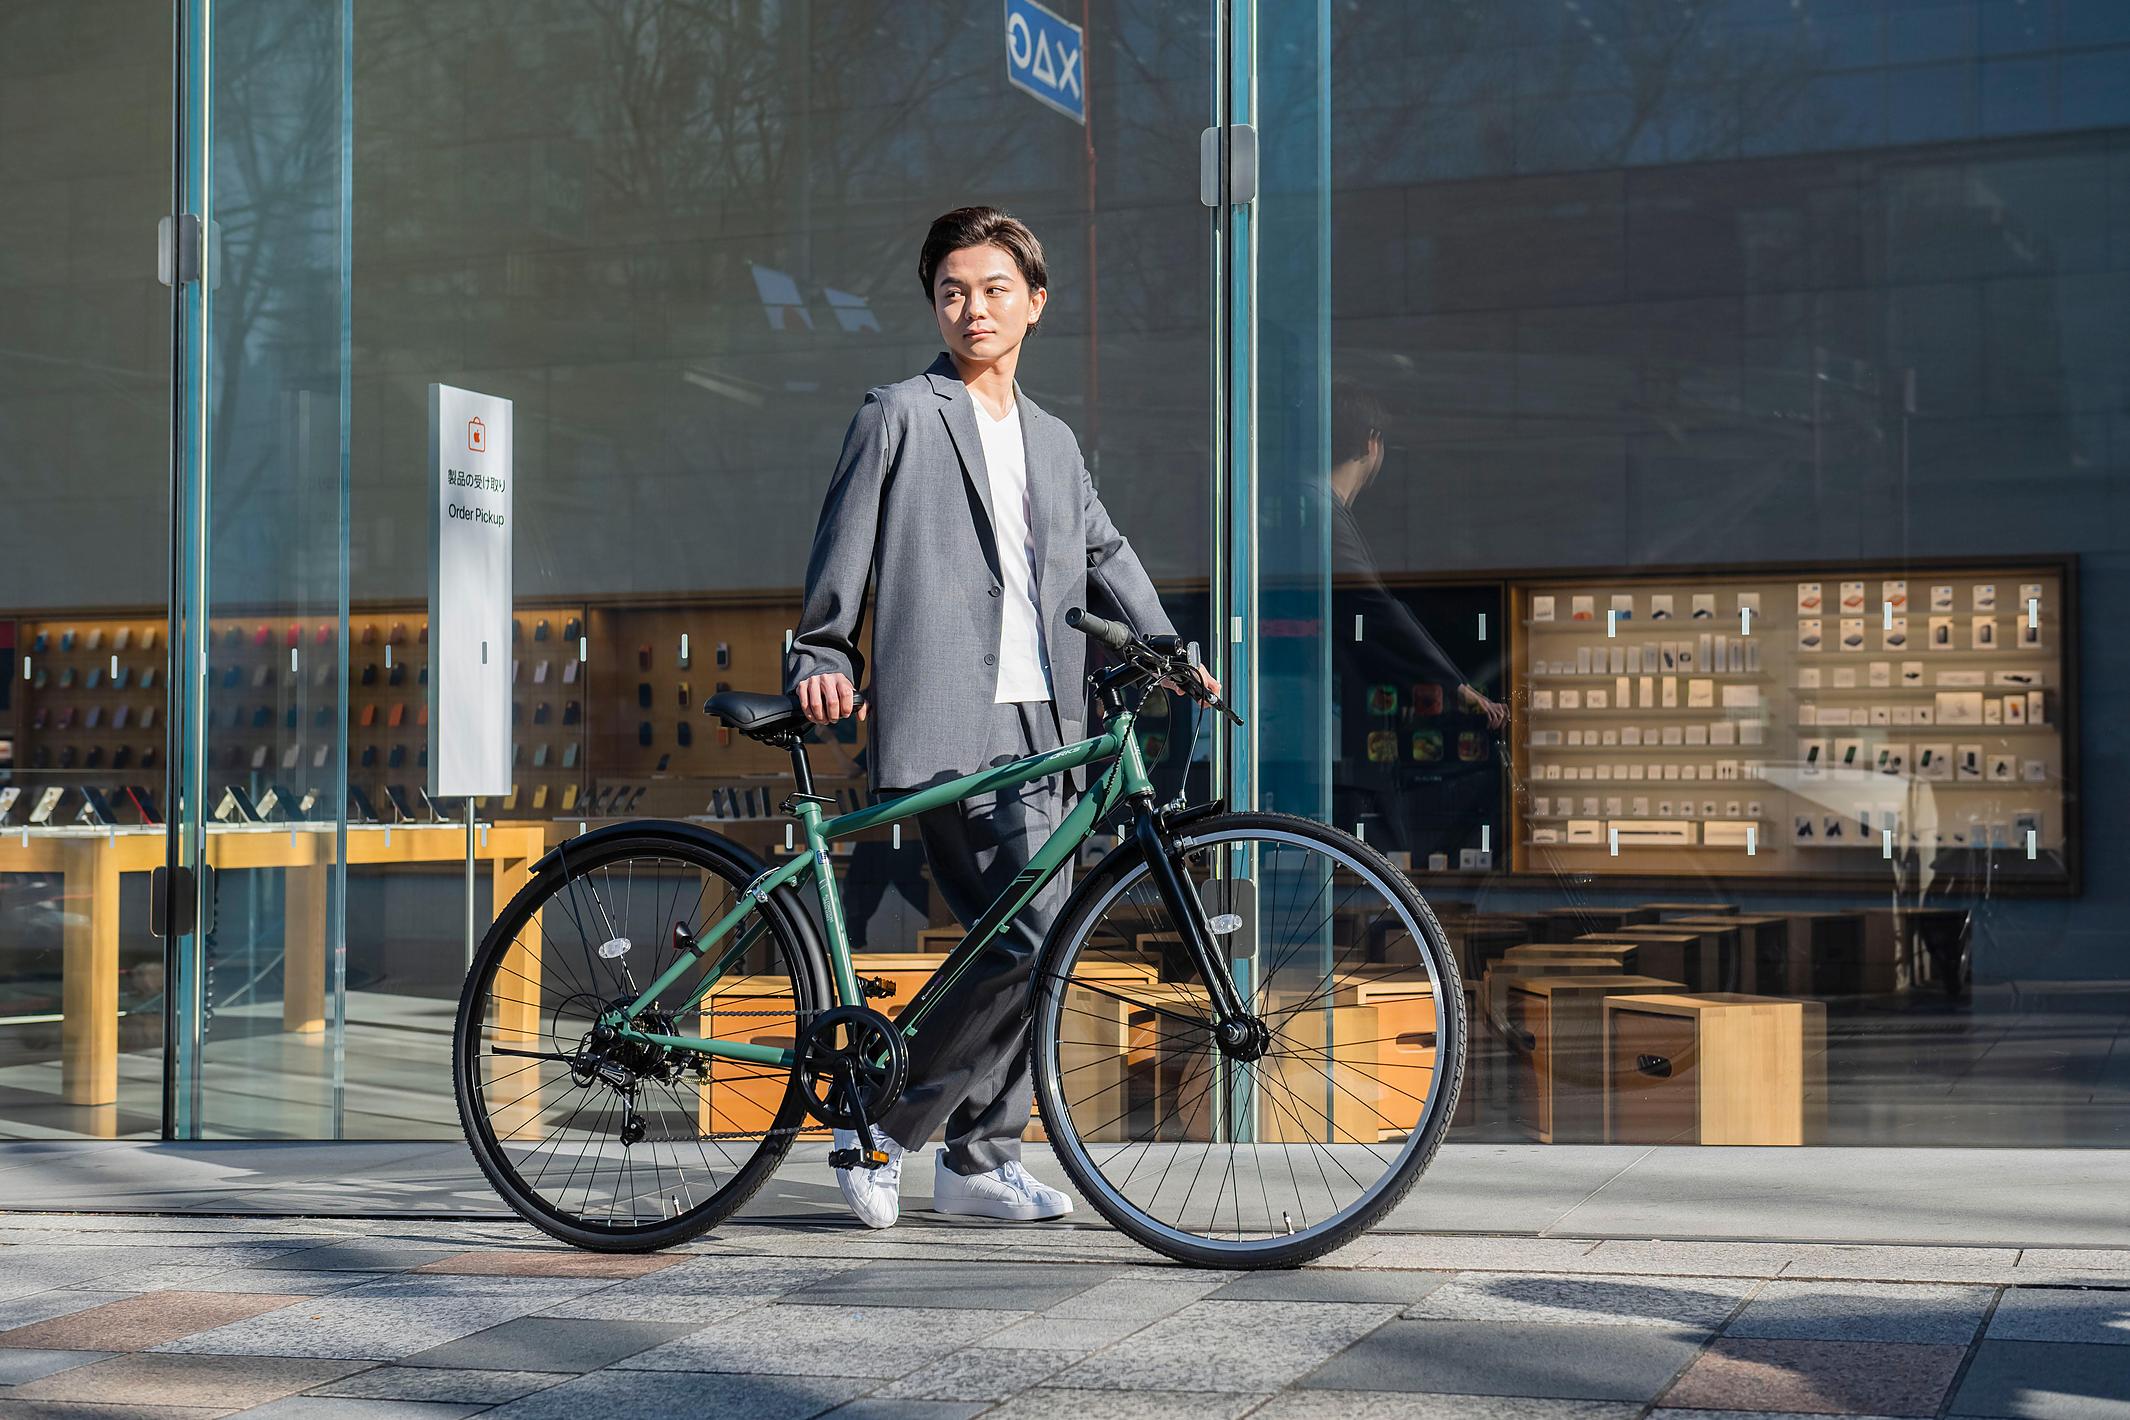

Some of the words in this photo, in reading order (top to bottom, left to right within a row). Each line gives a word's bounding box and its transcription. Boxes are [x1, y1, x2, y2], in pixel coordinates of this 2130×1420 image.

[448, 469, 505, 492] 製品の受け取り
[448, 503, 474, 521] Order
[475, 507, 504, 527] Pickup
